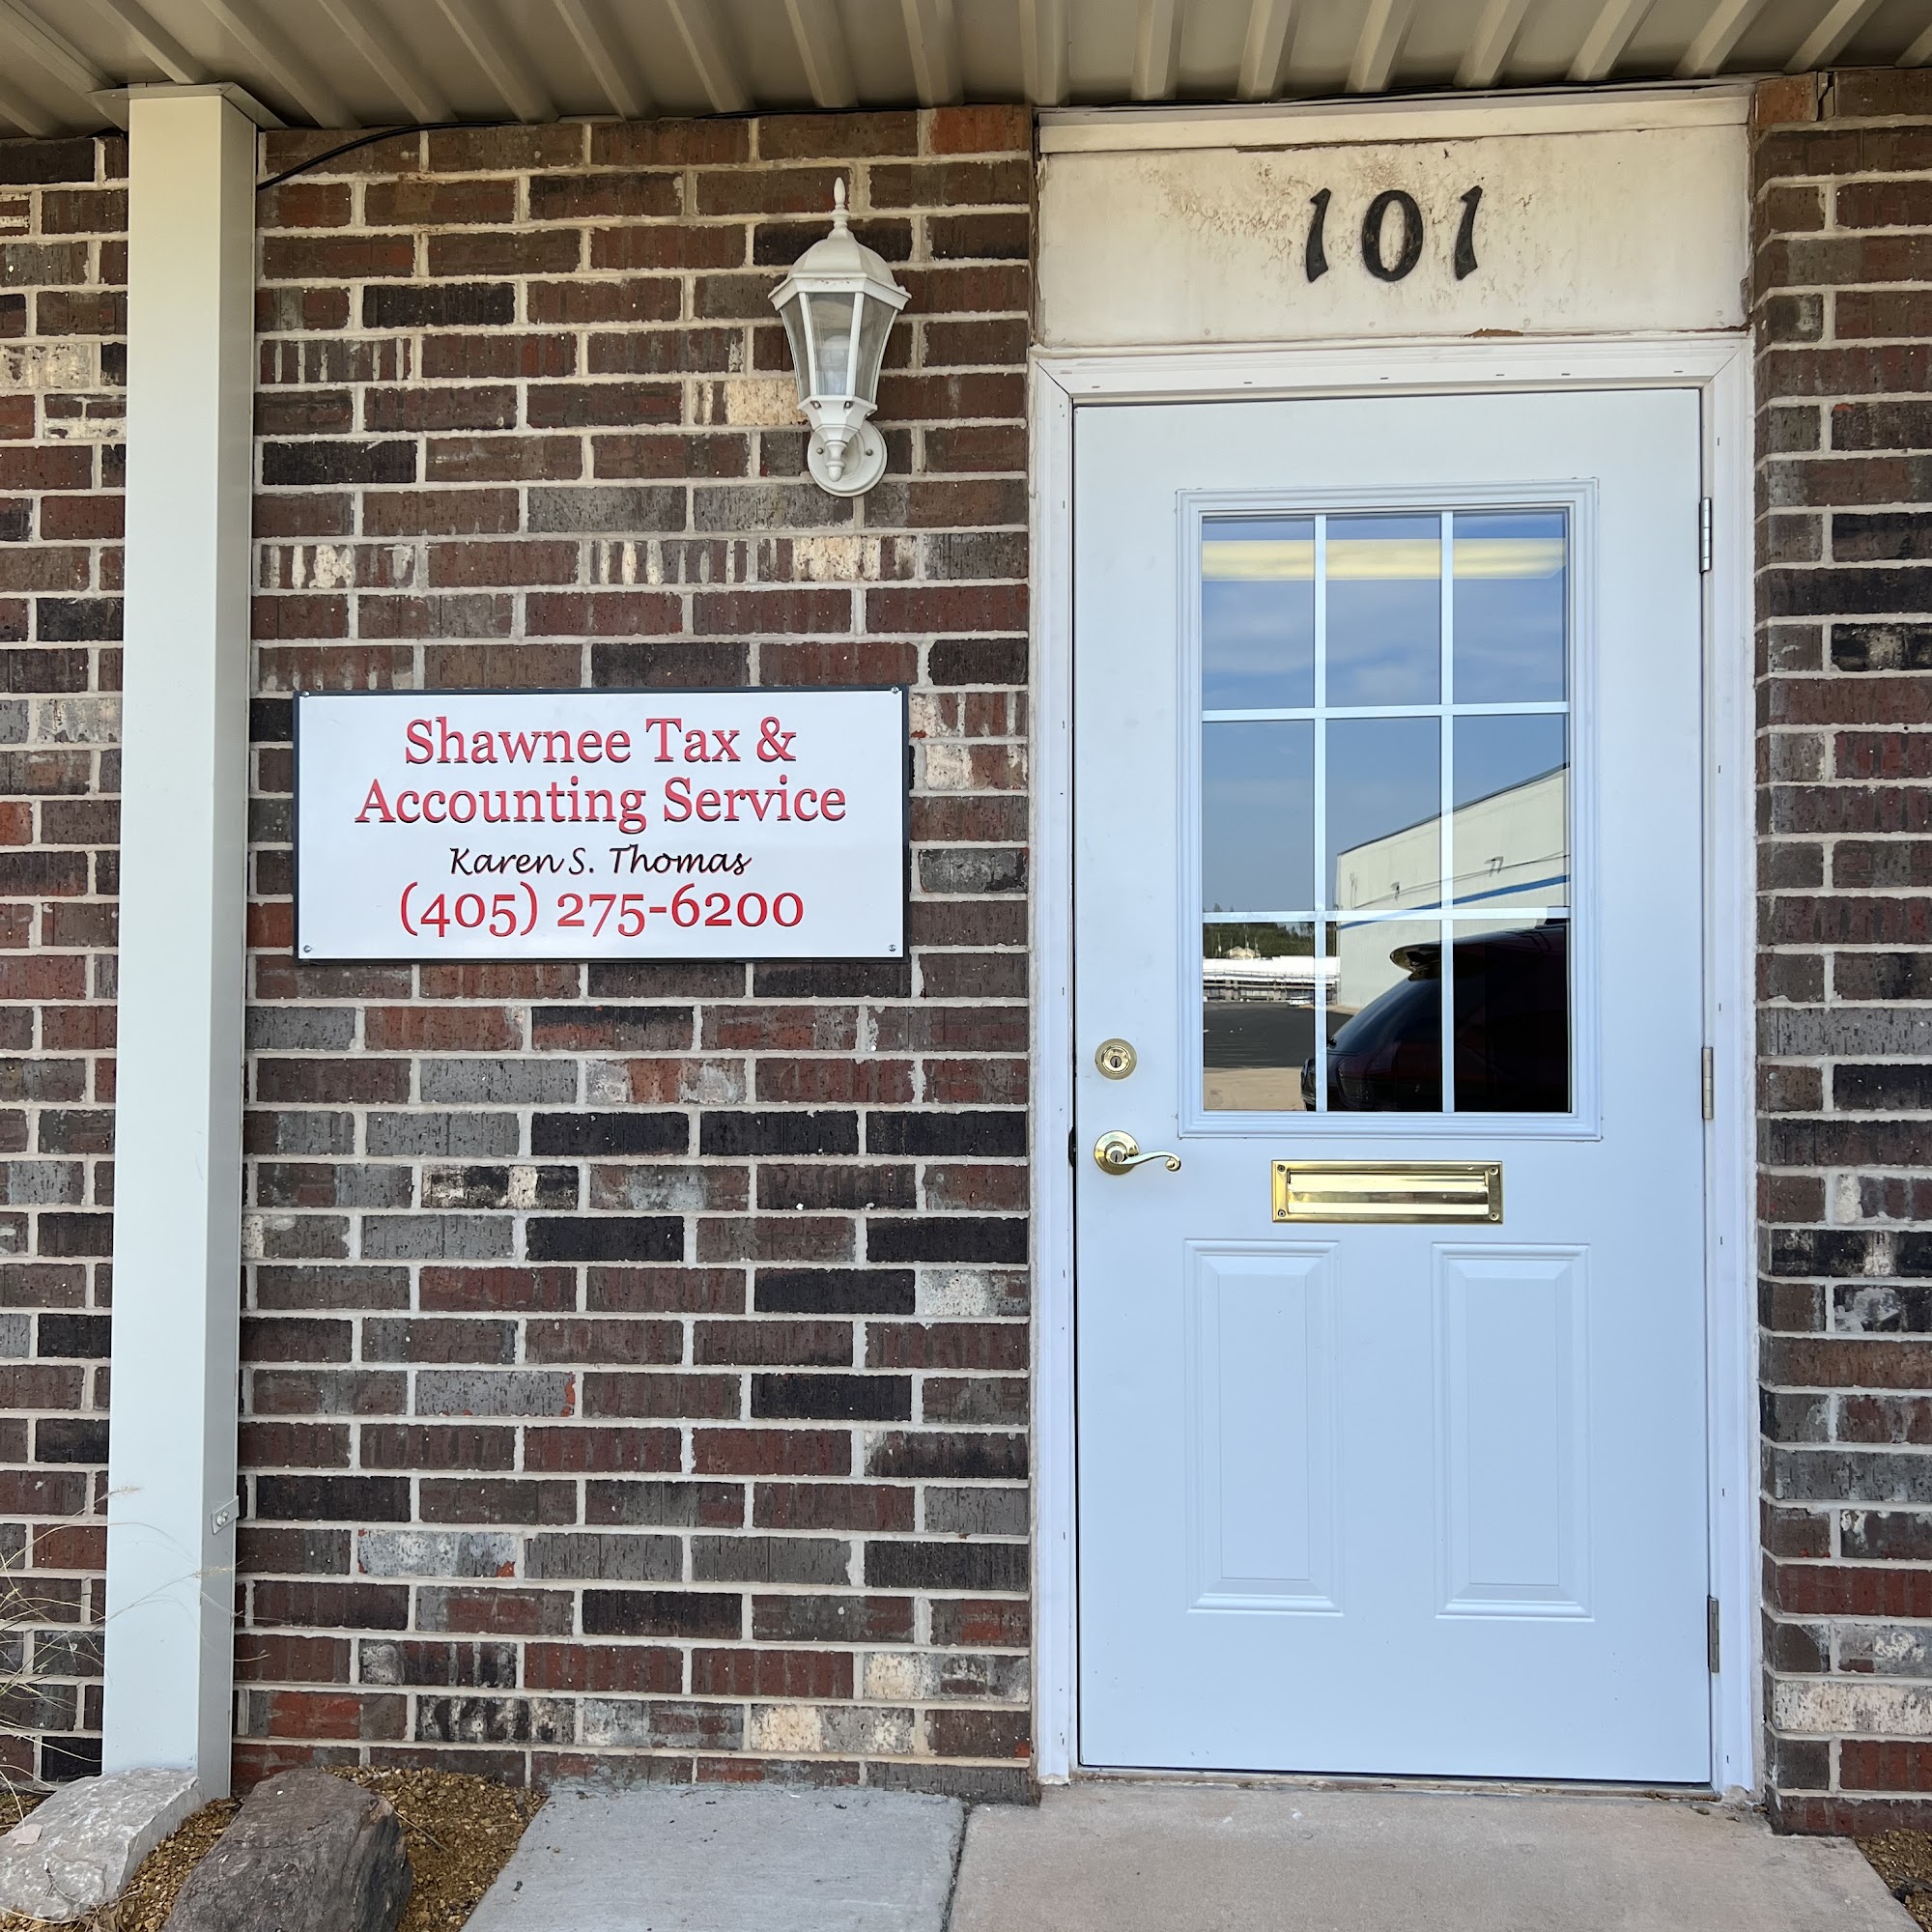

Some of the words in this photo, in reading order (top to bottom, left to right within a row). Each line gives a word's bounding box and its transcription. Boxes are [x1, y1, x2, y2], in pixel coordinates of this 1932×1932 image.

[1304, 184, 1484, 284] 101
[405, 716, 632, 765] Shawnee
[645, 718, 741, 764] Tax
[756, 716, 798, 763] &
[354, 775, 648, 836] Accounting
[664, 774, 847, 824] Service
[449, 847, 565, 876] Karen
[568, 846, 595, 876] S.
[609, 843, 753, 876] Thomas
[400, 881, 538, 938] (405)
[556, 882, 805, 938] 275-6200
